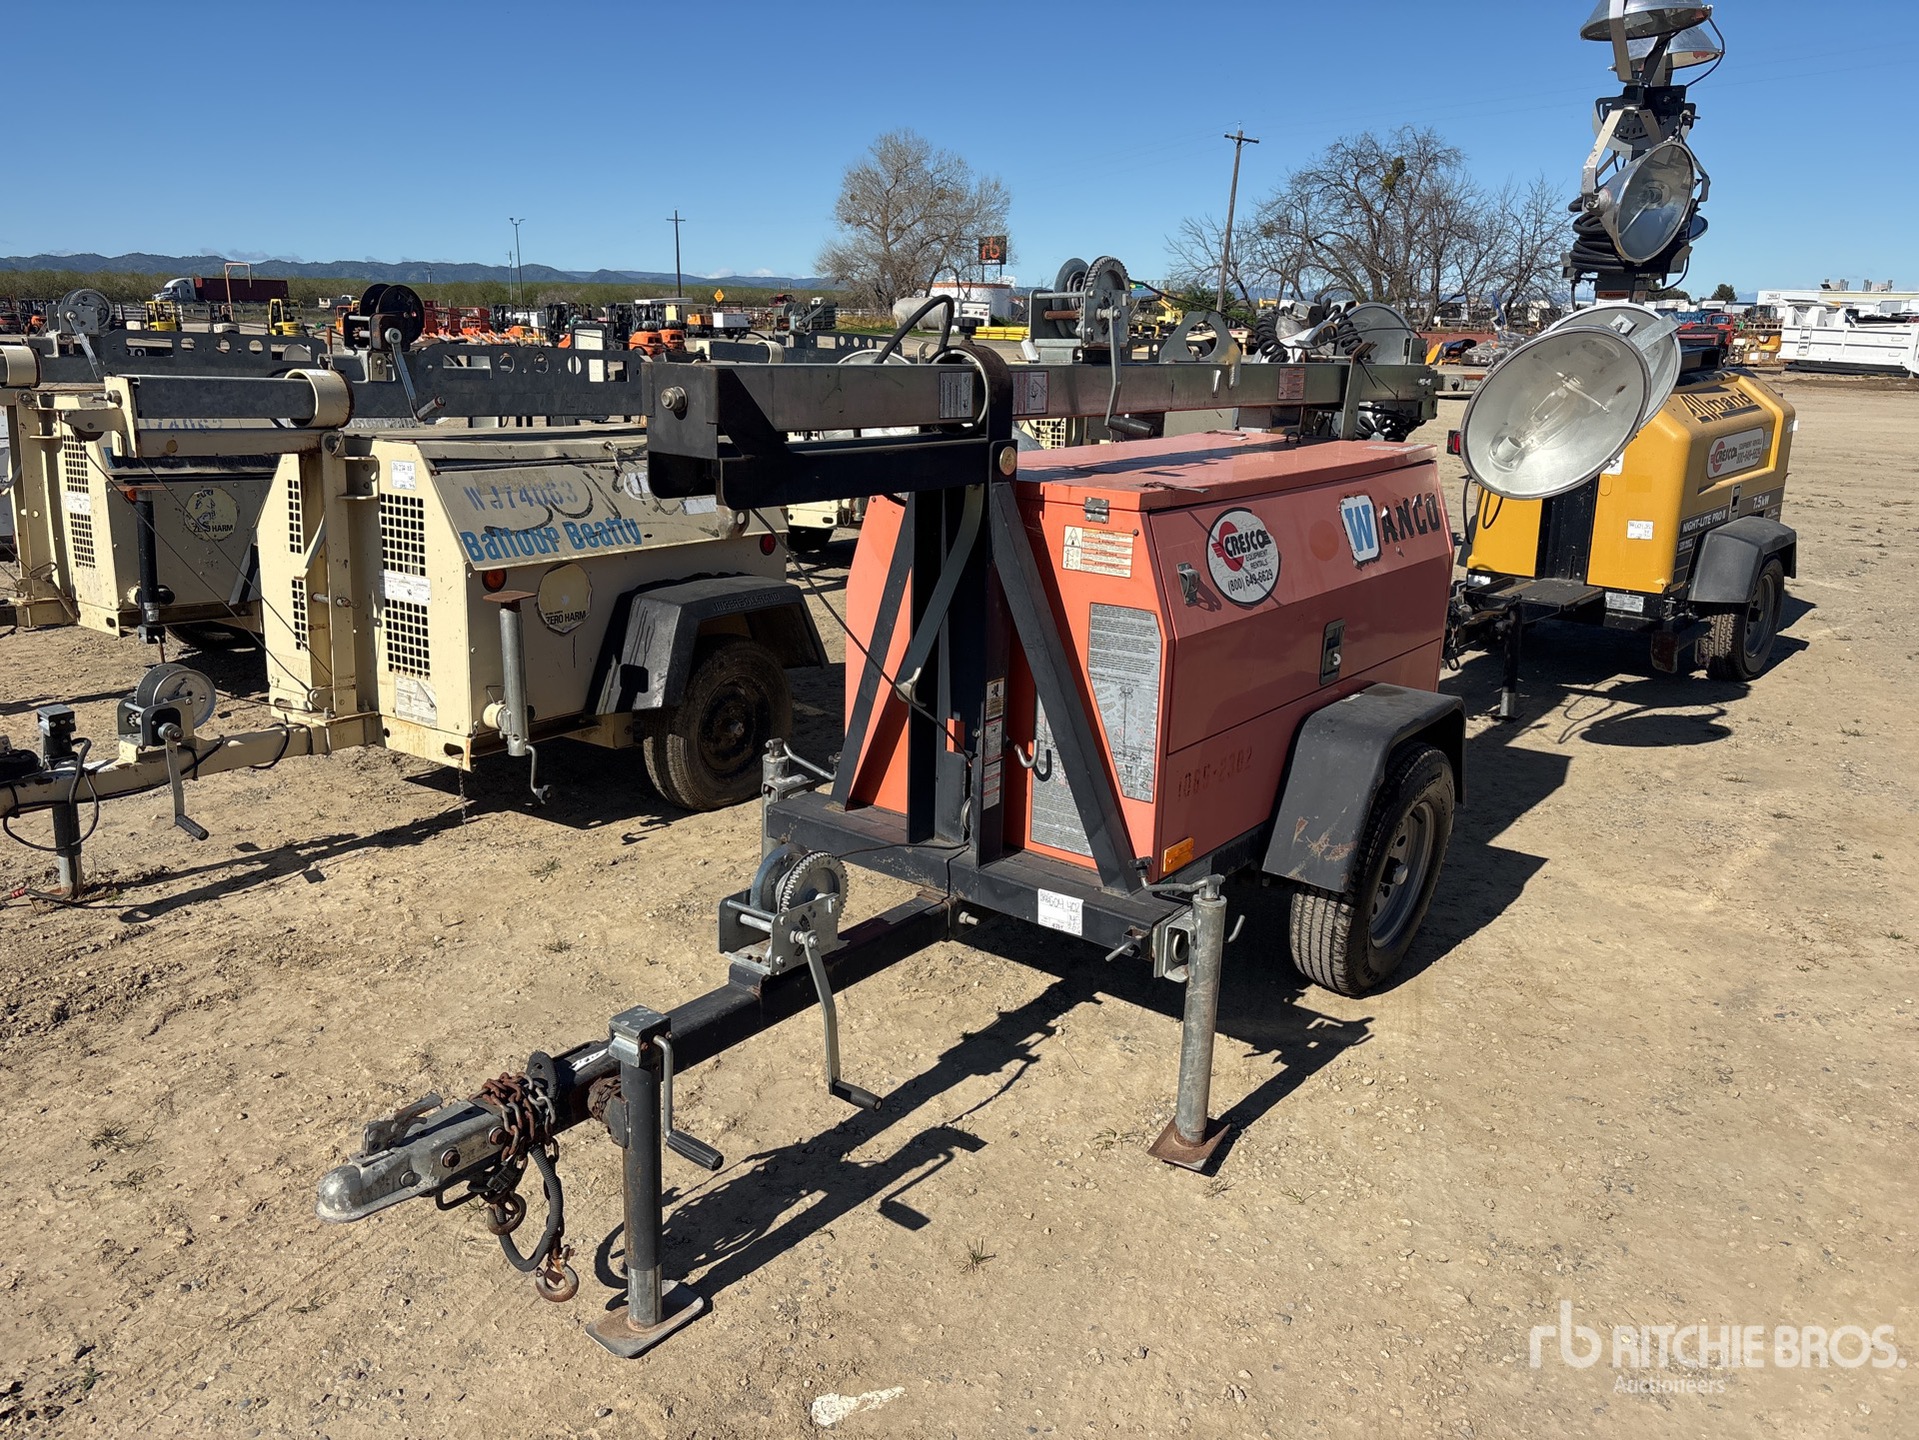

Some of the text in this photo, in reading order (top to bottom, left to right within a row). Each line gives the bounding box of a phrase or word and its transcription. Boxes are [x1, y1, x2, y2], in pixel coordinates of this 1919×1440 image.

[1679, 387, 1756, 422] Allmand
[212, 524, 233, 532] HARM
[1344, 492, 1440, 553] WANCO
[460, 516, 642, 562] Balfour Beatty
[1225, 528, 1271, 557] CRESCO
[1245, 549, 1269, 561] EQUIPMENT
[1250, 559, 1268, 570] RENTALS
[1228, 577, 1246, 595] (800)
[546, 614, 564, 625] ZERO
[564, 610, 587, 622] HARM
